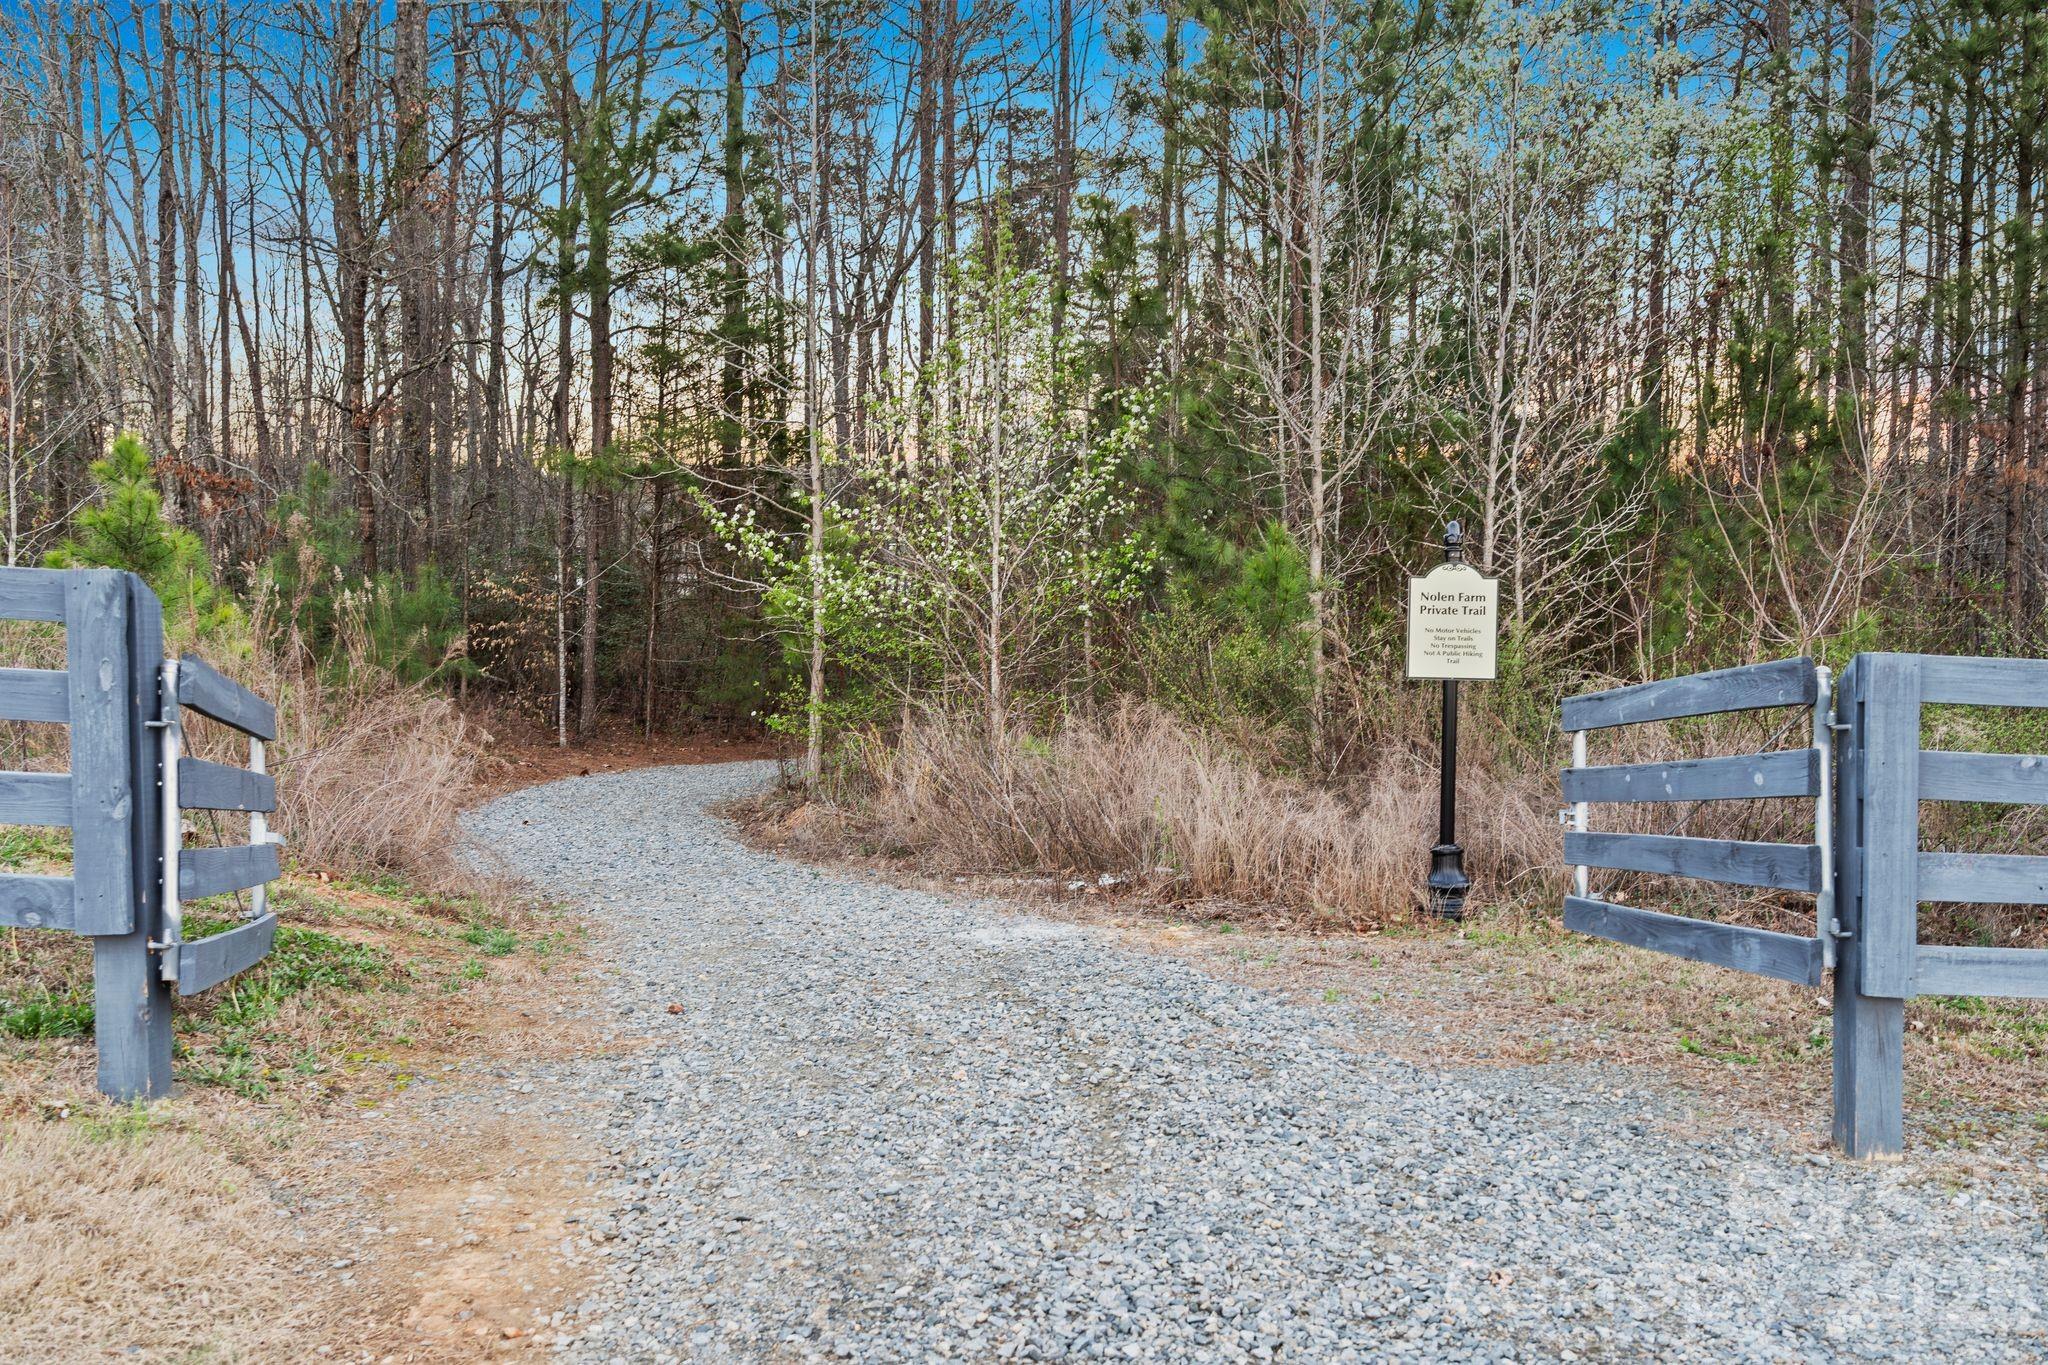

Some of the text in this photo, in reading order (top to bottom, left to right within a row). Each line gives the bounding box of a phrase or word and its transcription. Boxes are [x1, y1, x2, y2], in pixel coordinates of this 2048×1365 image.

[1420, 592, 1486, 602] Nolen Farm
[1420, 605, 1486, 616] Private Trail
